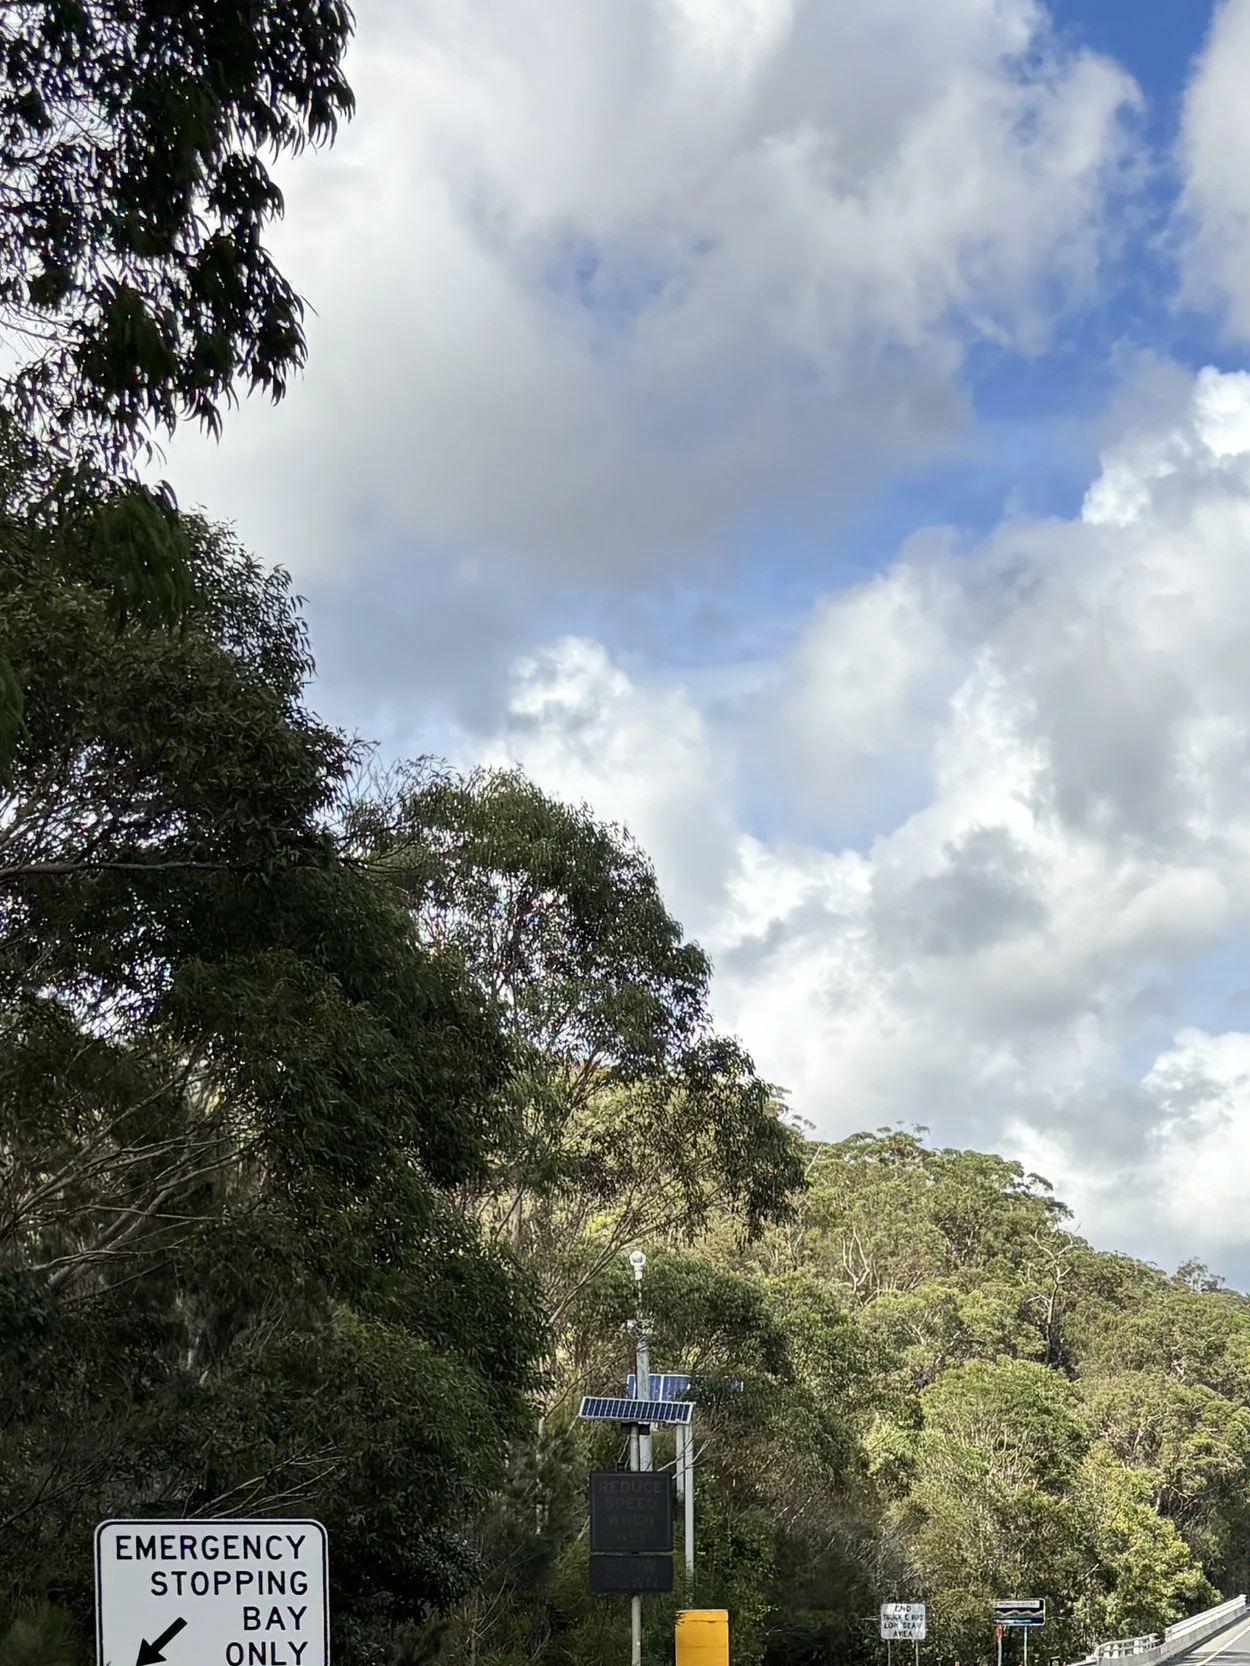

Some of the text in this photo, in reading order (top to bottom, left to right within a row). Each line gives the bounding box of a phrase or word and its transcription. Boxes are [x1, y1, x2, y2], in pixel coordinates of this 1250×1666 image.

[598, 1481, 663, 1494] REDUCE
[604, 1497, 658, 1509] SPEED
[608, 1514, 655, 1526] WHEN
[616, 1530, 645, 1542] WET
[116, 1535, 306, 1560] EMERGENCY
[604, 1558, 656, 1572] SLOW
[151, 1571, 308, 1596] STOPPING
[243, 1606, 308, 1631] BAY
[226, 1641, 308, 1666] ONLY
